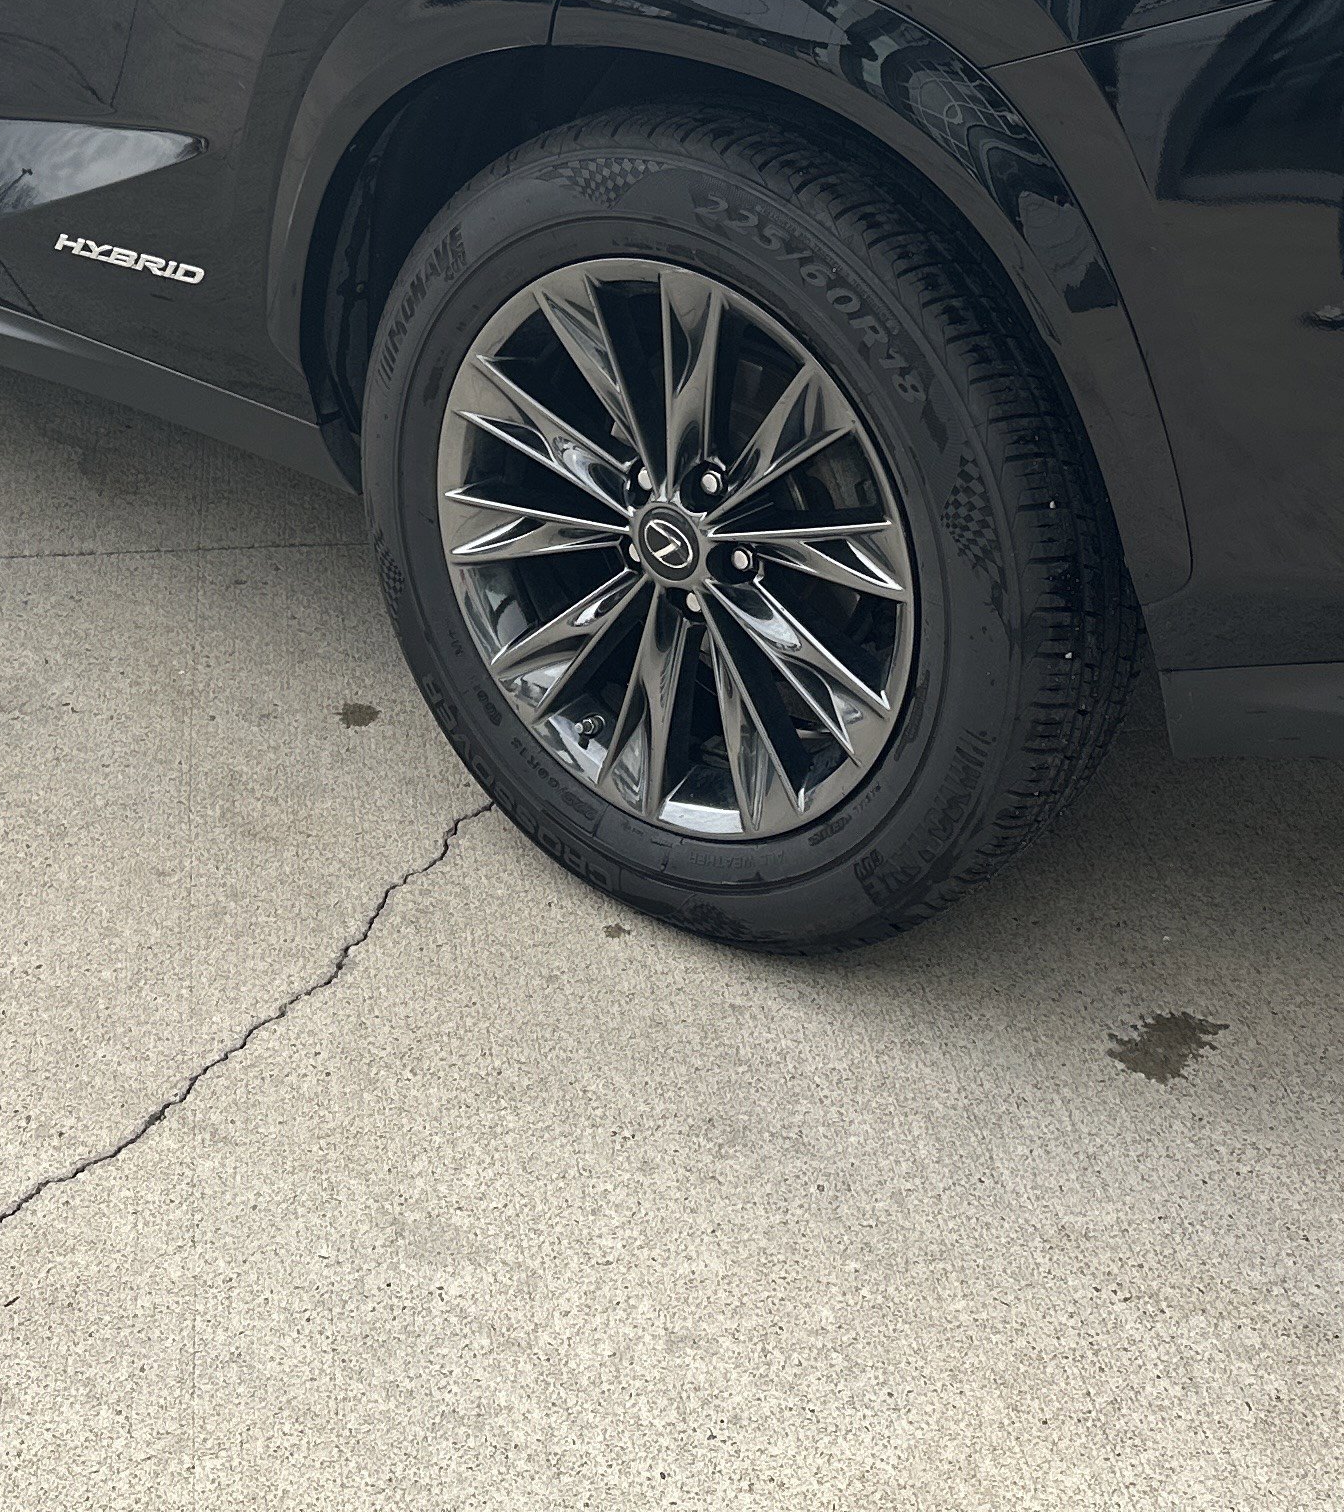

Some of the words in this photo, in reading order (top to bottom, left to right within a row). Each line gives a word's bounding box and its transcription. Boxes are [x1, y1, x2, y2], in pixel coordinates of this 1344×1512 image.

[54, 233, 205, 284] HYBRID
[388, 221, 463, 354] MOHAVE
[693, 193, 926, 403] 225/60R18
[421, 673, 610, 890] CROSSOVER
